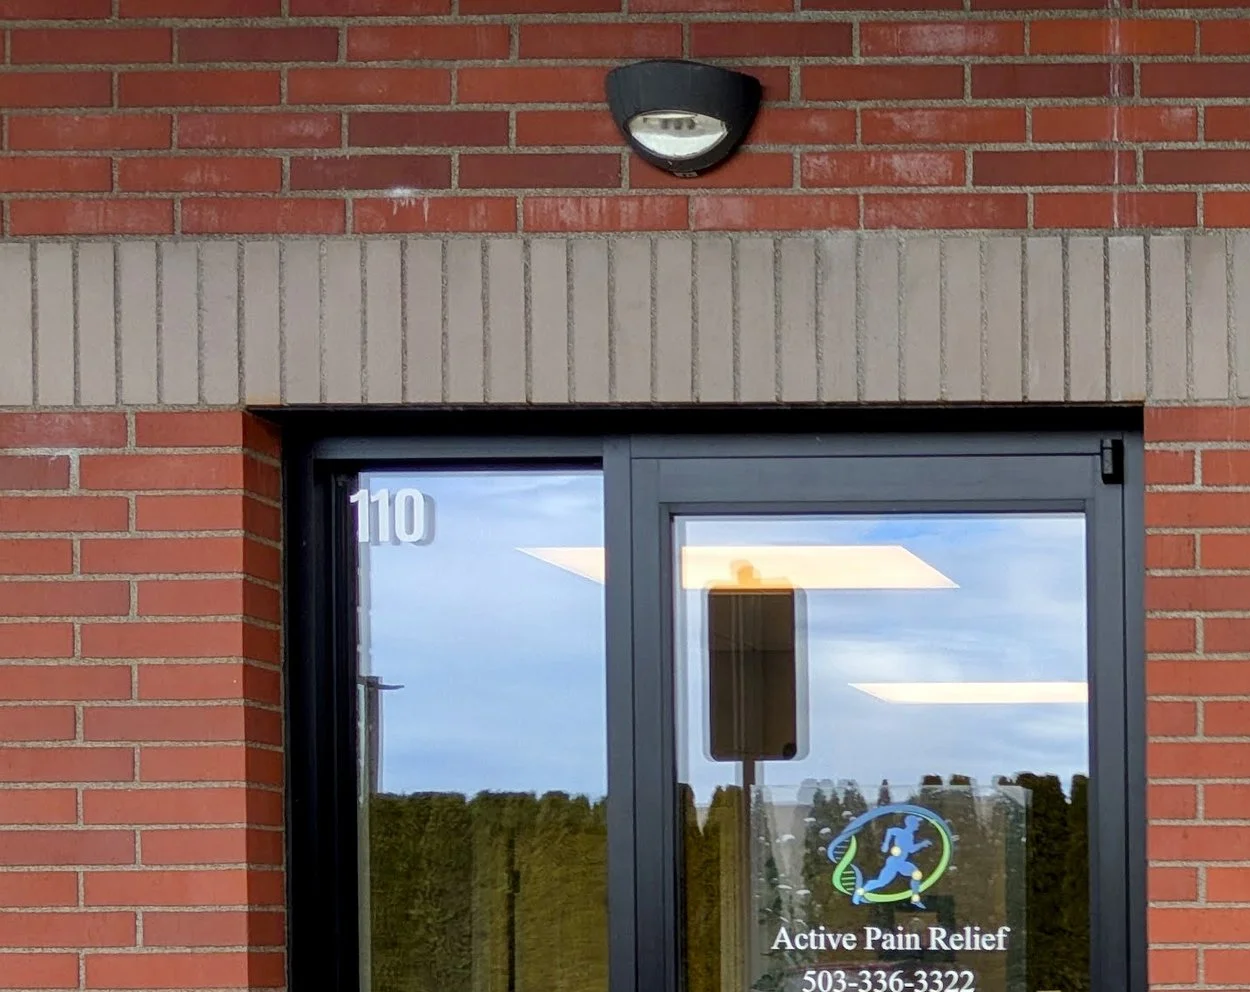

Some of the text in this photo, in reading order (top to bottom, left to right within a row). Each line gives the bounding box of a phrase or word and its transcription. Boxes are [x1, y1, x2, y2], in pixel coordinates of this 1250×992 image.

[349, 488, 425, 543] 110
[771, 925, 1011, 951] Active Pain Relief
